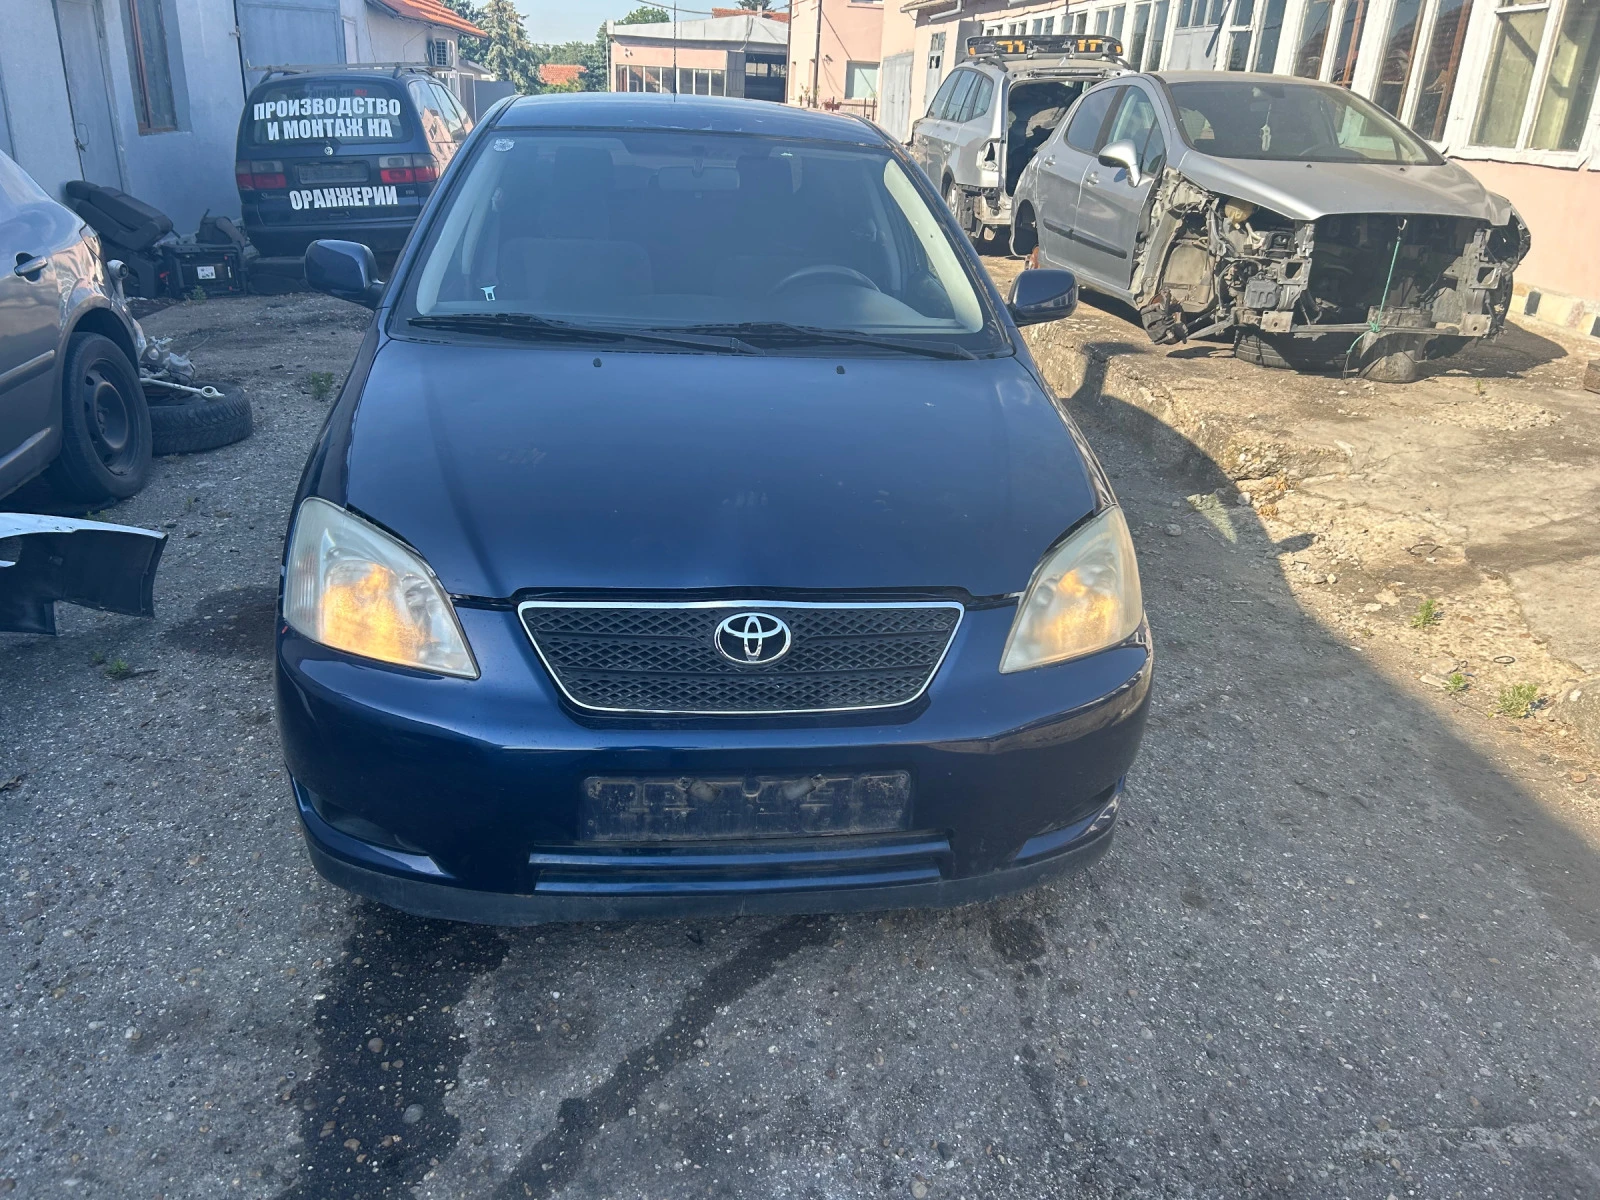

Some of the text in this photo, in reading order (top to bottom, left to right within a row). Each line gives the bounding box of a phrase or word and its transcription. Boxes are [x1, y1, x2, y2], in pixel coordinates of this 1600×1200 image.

[253, 97, 401, 121] ПРОИЗВОДСТВО
[267, 118, 393, 141] И МОНТАЖ НА
[289, 185, 399, 211] ОРАНЖЕРИИ
